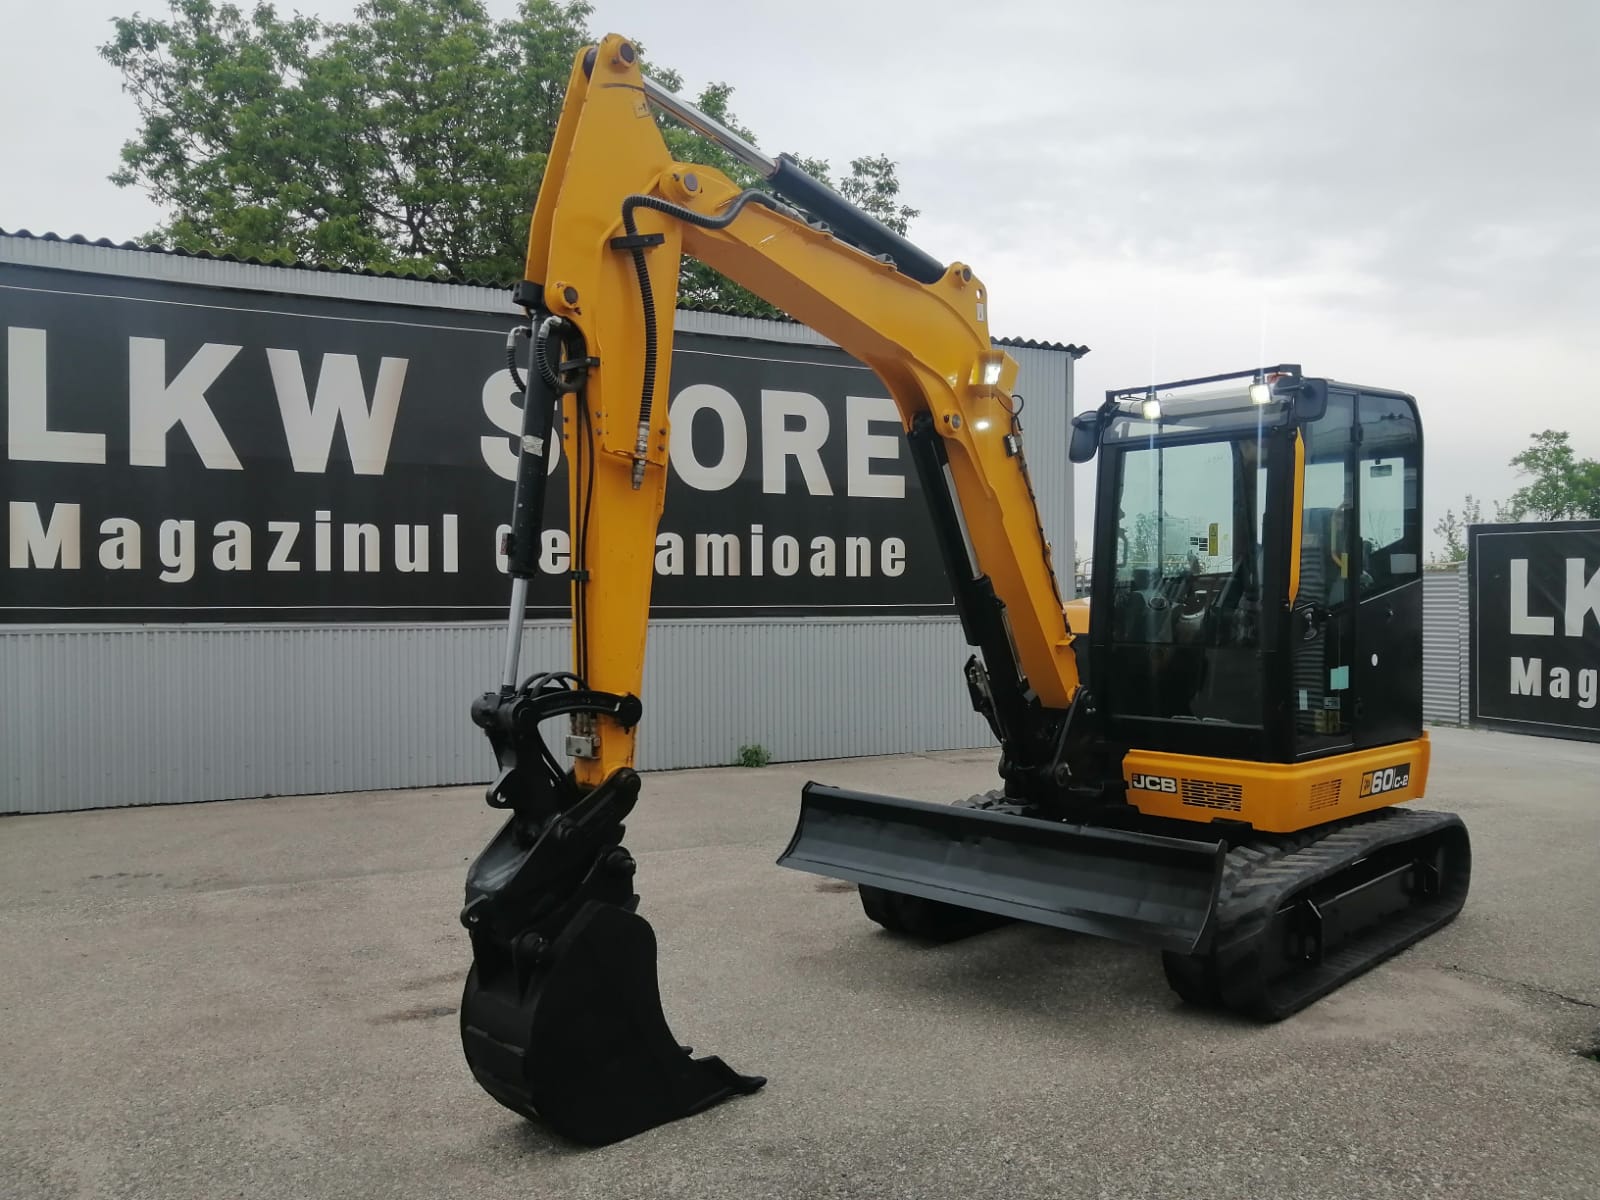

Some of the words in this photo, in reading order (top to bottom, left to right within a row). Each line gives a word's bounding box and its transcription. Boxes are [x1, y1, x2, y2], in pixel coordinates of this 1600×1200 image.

[8, 326, 409, 475] LKW
[480, 368, 905, 499] SORE
[9, 502, 459, 583] Magazinul
[655, 524, 906, 577] amioane
[1510, 558, 1600, 637] LK
[1510, 657, 1598, 709] Mag
[1133, 775, 1177, 792] JCB
